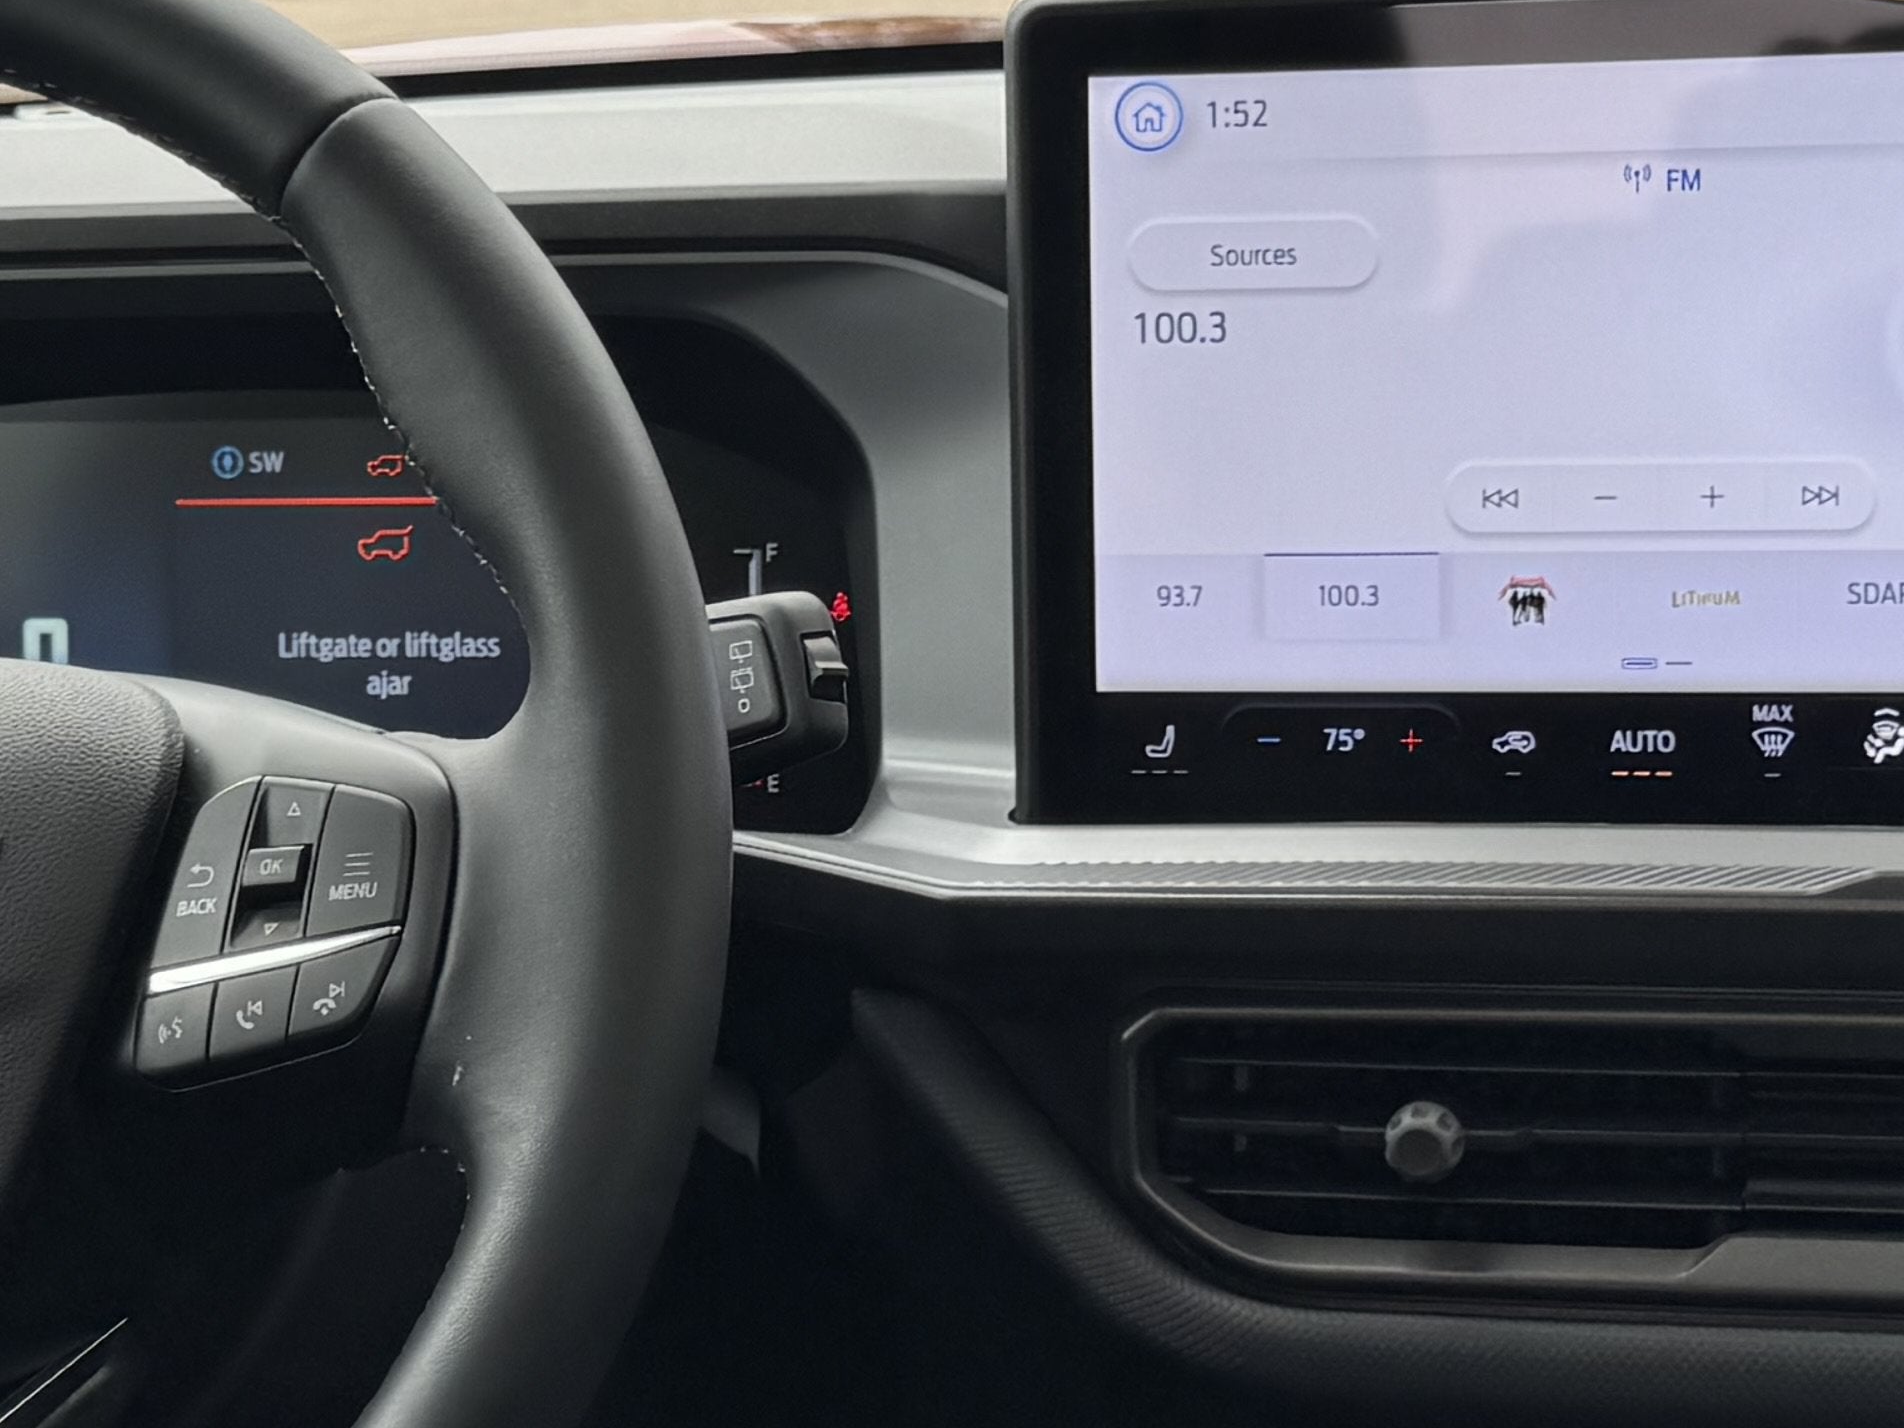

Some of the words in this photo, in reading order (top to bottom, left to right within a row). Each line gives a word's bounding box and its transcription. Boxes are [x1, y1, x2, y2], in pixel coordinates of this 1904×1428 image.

[1206, 98, 1269, 129] 1:52
[1665, 169, 1702, 192] FM
[1209, 243, 1298, 268] Sources
[1133, 311, 1228, 345] 100.3
[248, 451, 285, 474] SW
[765, 542, 779, 562] F
[1156, 584, 1203, 608] 93.7
[1317, 584, 1380, 608] 100.3
[278, 631, 373, 663] Liftgate
[376, 637, 402, 659] or
[404, 630, 502, 663] liftglass
[365, 670, 413, 700] ajar
[1752, 705, 1794, 722] MAX
[1323, 727, 1366, 752] 75°
[1610, 730, 1677, 754] AUTO
[767, 773, 780, 793] E
[259, 858, 284, 876] OK
[328, 882, 378, 901] MENU
[176, 896, 218, 917] BACK
